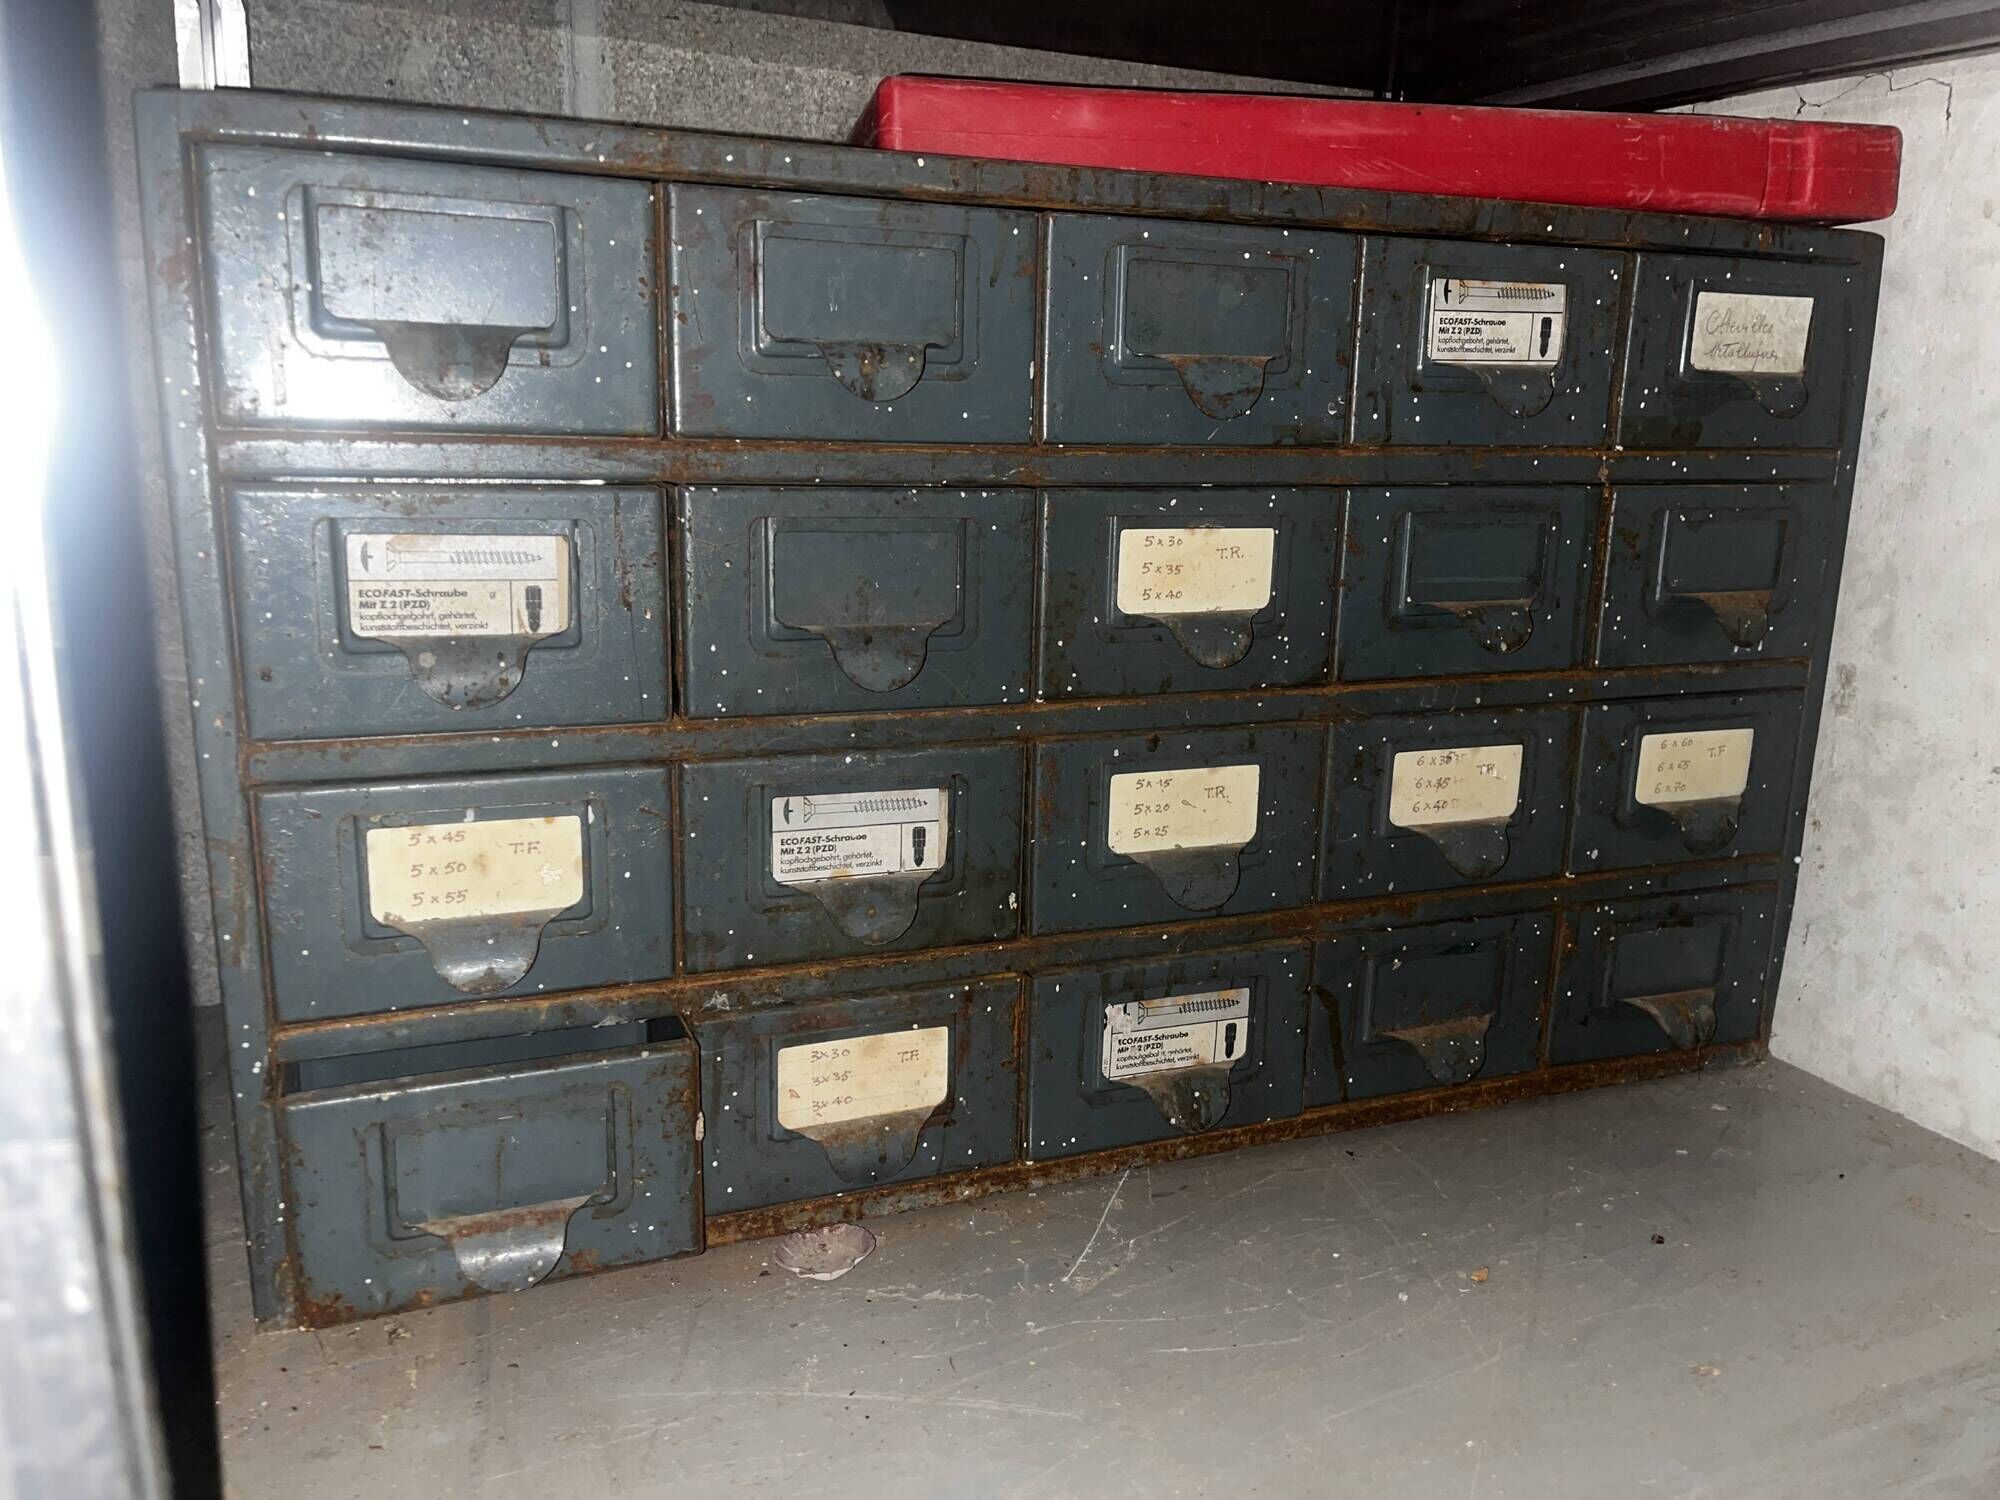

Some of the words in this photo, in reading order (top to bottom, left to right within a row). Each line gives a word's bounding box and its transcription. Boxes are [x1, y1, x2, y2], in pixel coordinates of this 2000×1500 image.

[1439, 317, 1506, 326] ECOFAST-Schraube
[1438, 327, 1450, 335] Mit
[1463, 327, 1483, 336] (PZD)
[358, 589, 468, 598] ECOFAST-Schraube
[359, 600, 377, 609] Mit
[380, 600, 388, 609] Z
[390, 600, 397, 609] 2
[399, 600, 431, 610] (PZD)
[455, 621, 488, 630] verzinkt
[780, 833, 867, 846] ECOFAST-Schraube
[780, 847, 795, 856] Mit
[805, 846, 811, 854] 2
[812, 844, 837, 855] (PZD)
[855, 860, 882, 868] verzinkt
[1118, 1031, 1189, 1046] ECOFAST-Schraube
[1143, 1042, 1164, 1052] (PZD)
